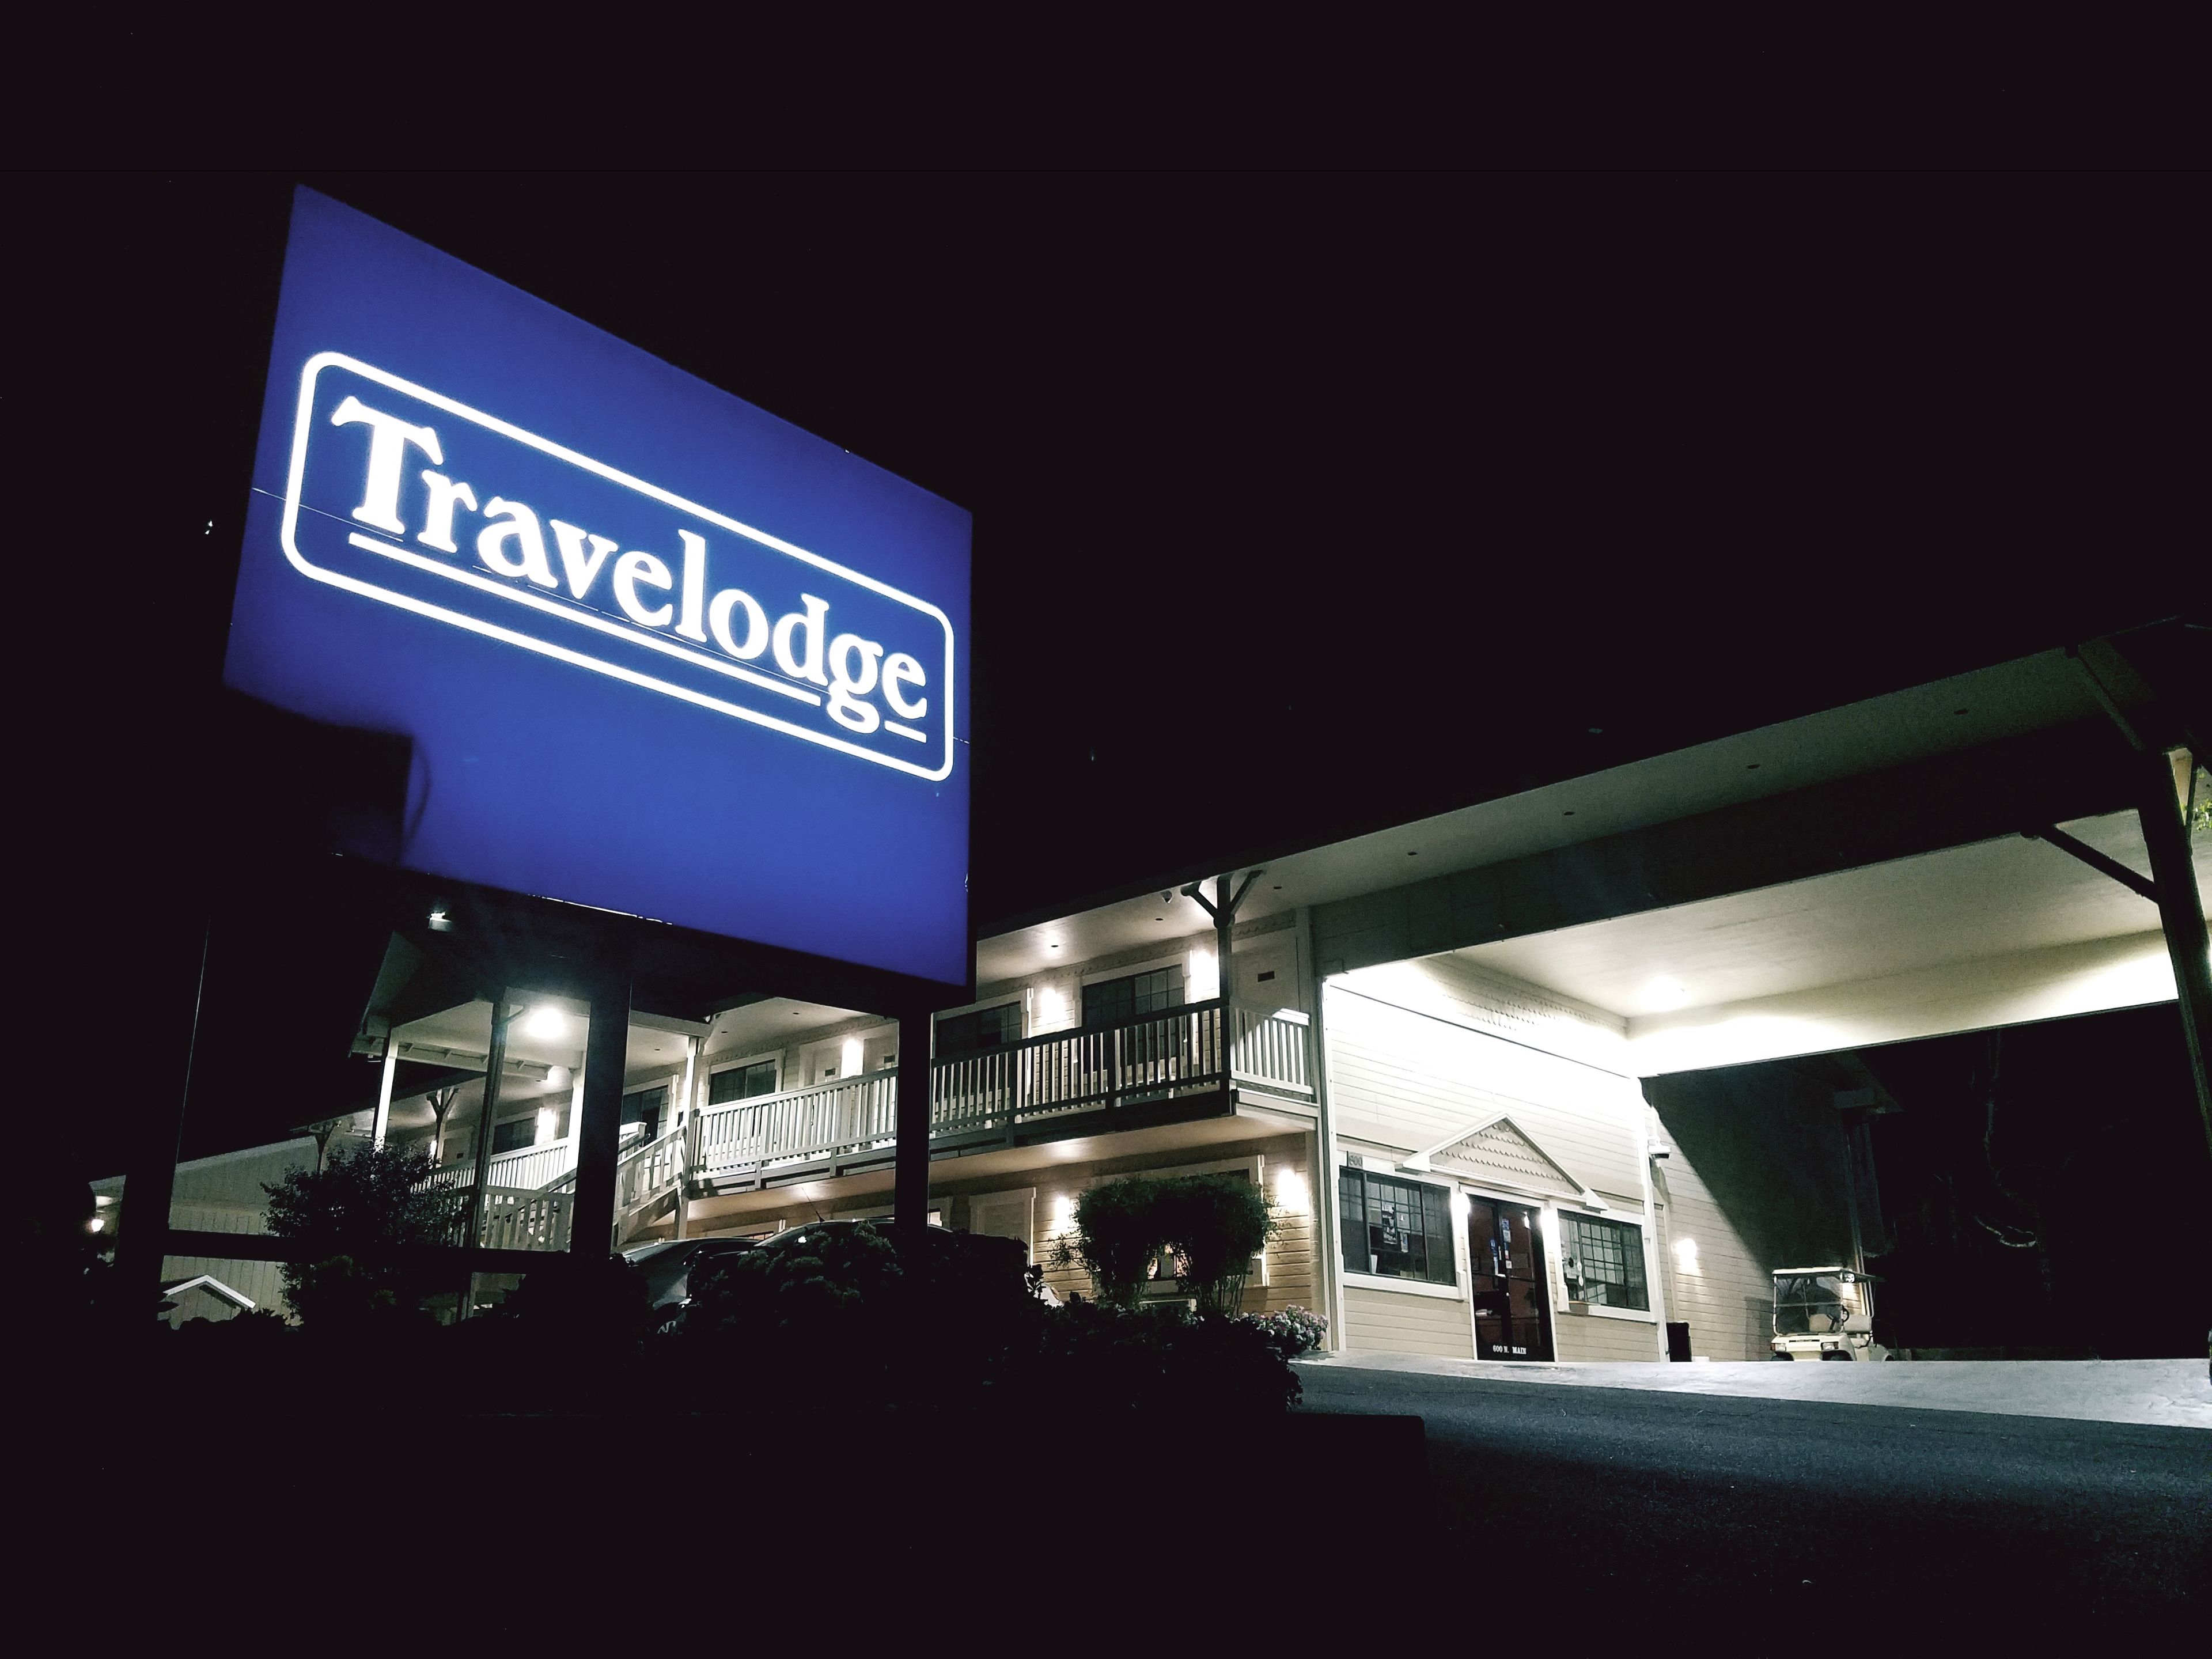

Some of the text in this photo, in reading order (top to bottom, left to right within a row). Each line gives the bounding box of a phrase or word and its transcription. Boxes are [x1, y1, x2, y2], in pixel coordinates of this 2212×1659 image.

[331, 396, 927, 734] Travelodge
[1493, 1344, 1503, 1353] 600
[1512, 1346, 1527, 1354] MAIN
